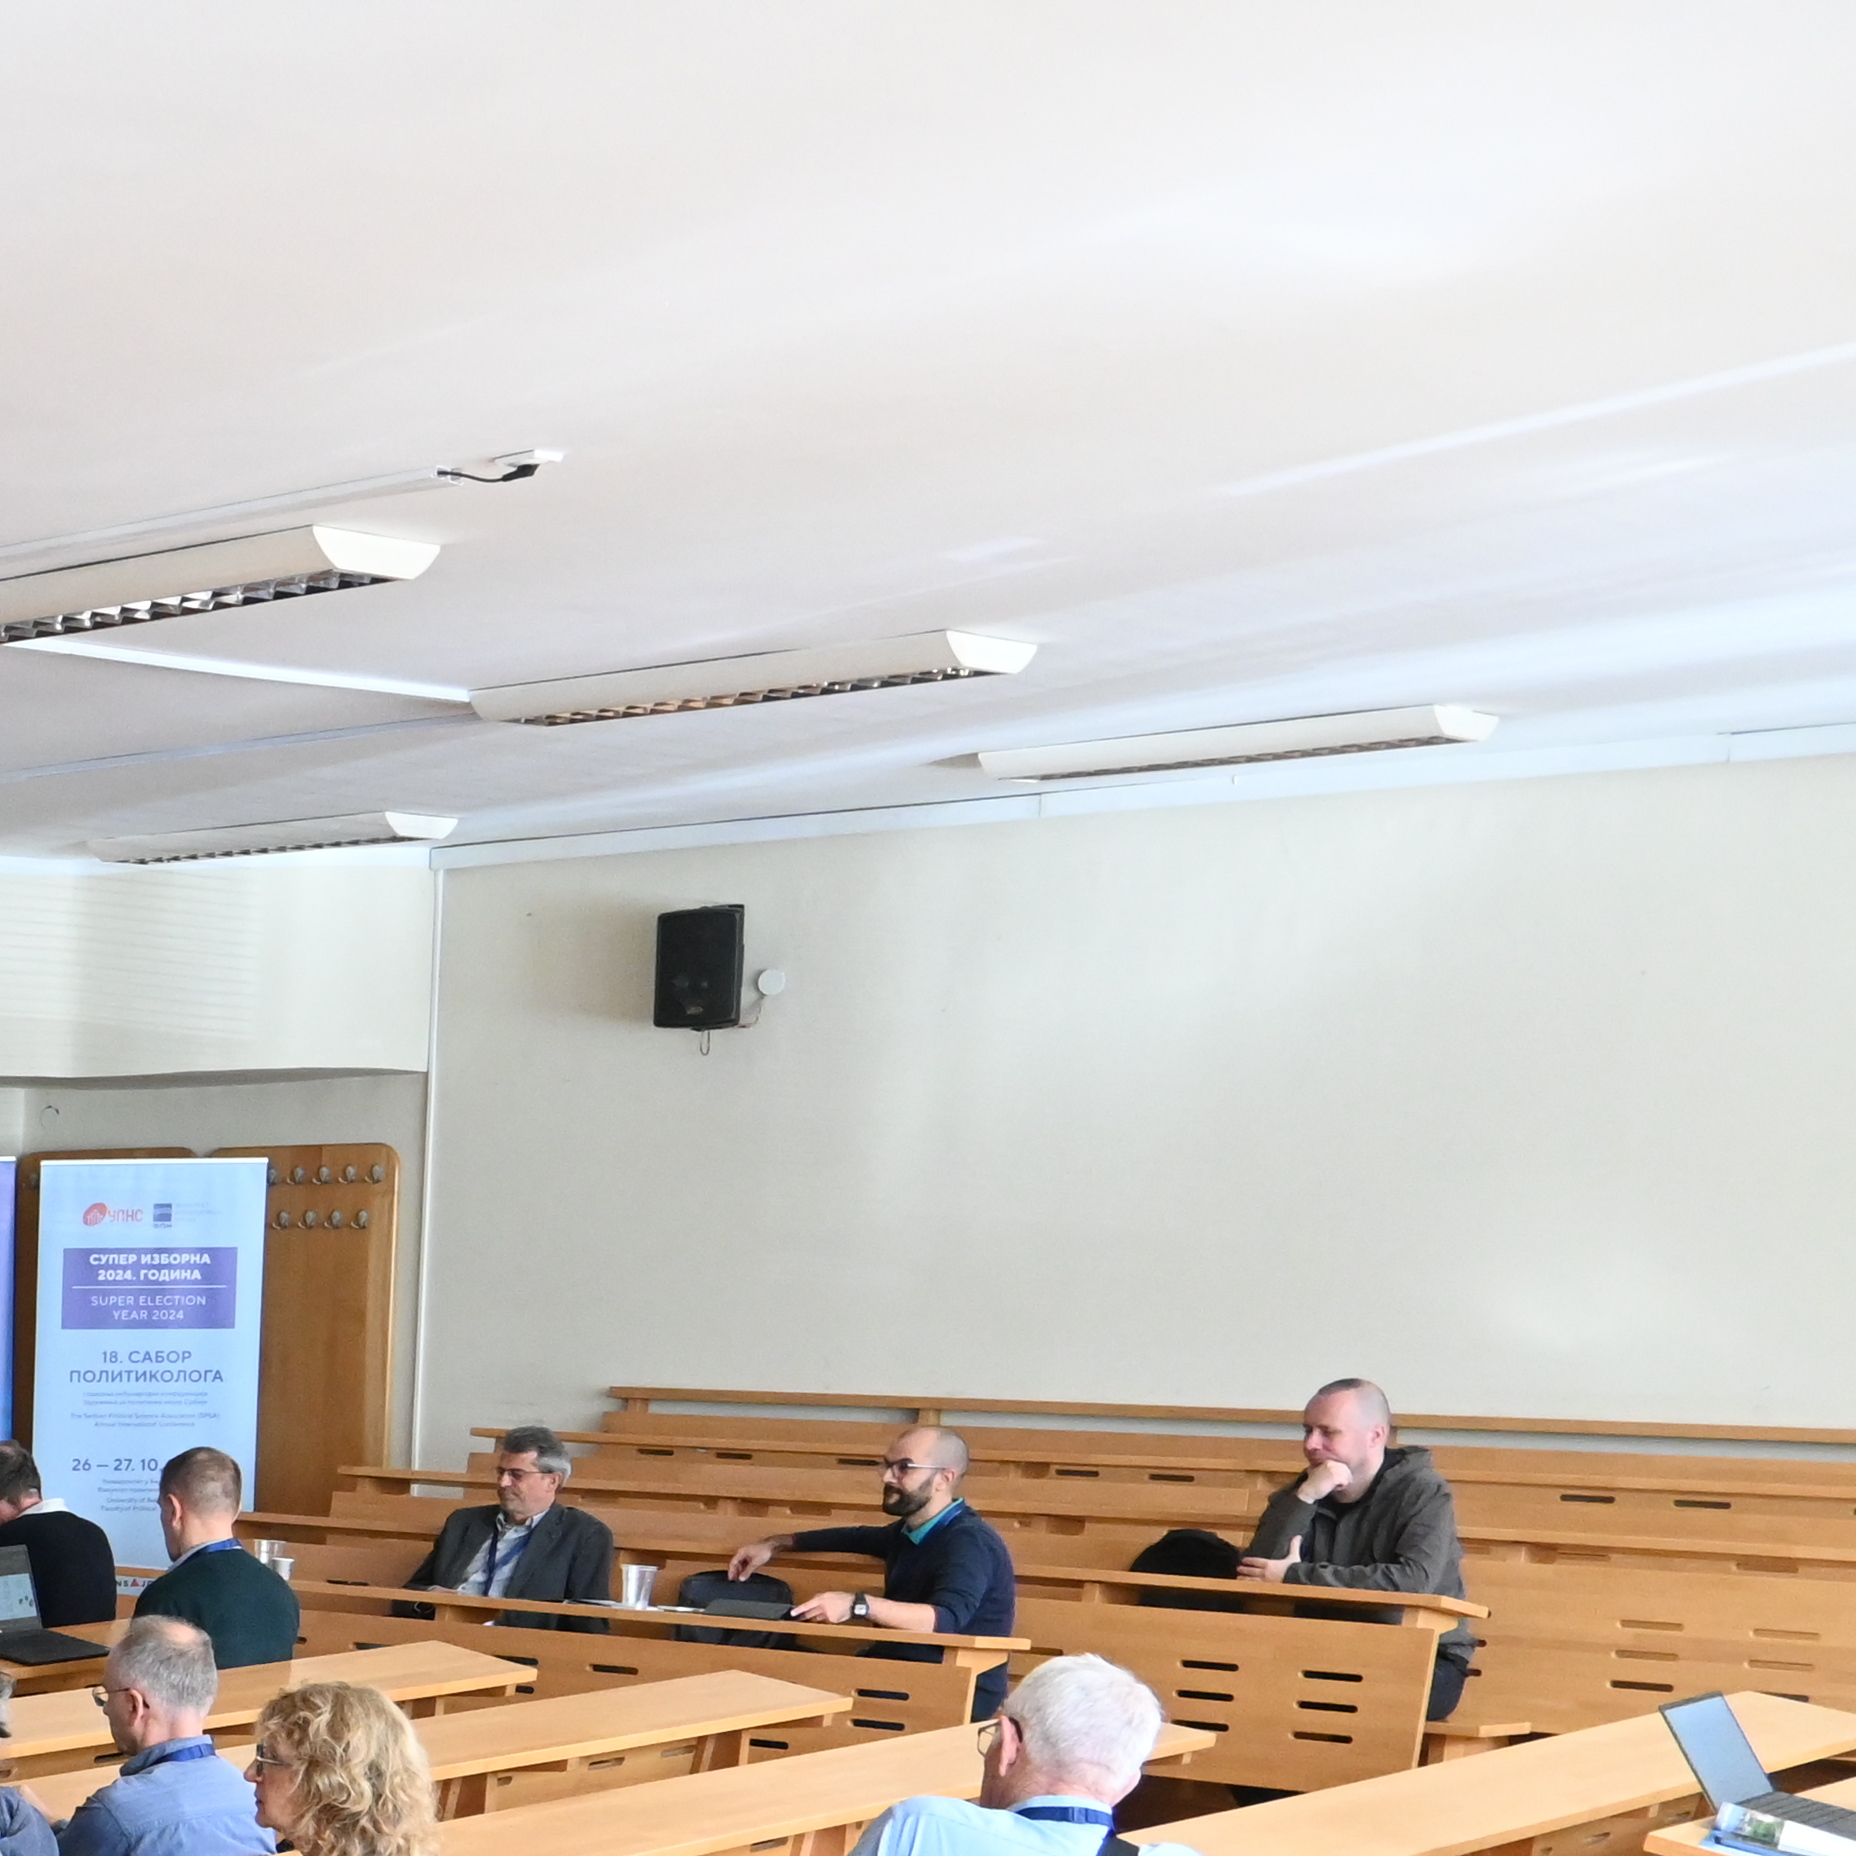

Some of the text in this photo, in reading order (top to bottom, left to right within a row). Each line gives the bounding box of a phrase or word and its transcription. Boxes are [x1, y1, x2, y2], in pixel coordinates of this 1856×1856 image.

[108, 1208, 144, 1223] УПНС
[89, 1253, 211, 1265] СУПЕР ИЗБОРНА
[97, 1269, 202, 1282] 2024. ГОДИНА
[91, 1295, 207, 1307] SUPER ELECTION
[113, 1309, 185, 1321] YEAR 2024
[102, 1350, 192, 1364] 18. САБОР
[69, 1370, 224, 1383] ПОЛИТИКОЛОГА
[72, 1459, 92, 1471] 26
[113, 1459, 135, 1471] 27.
